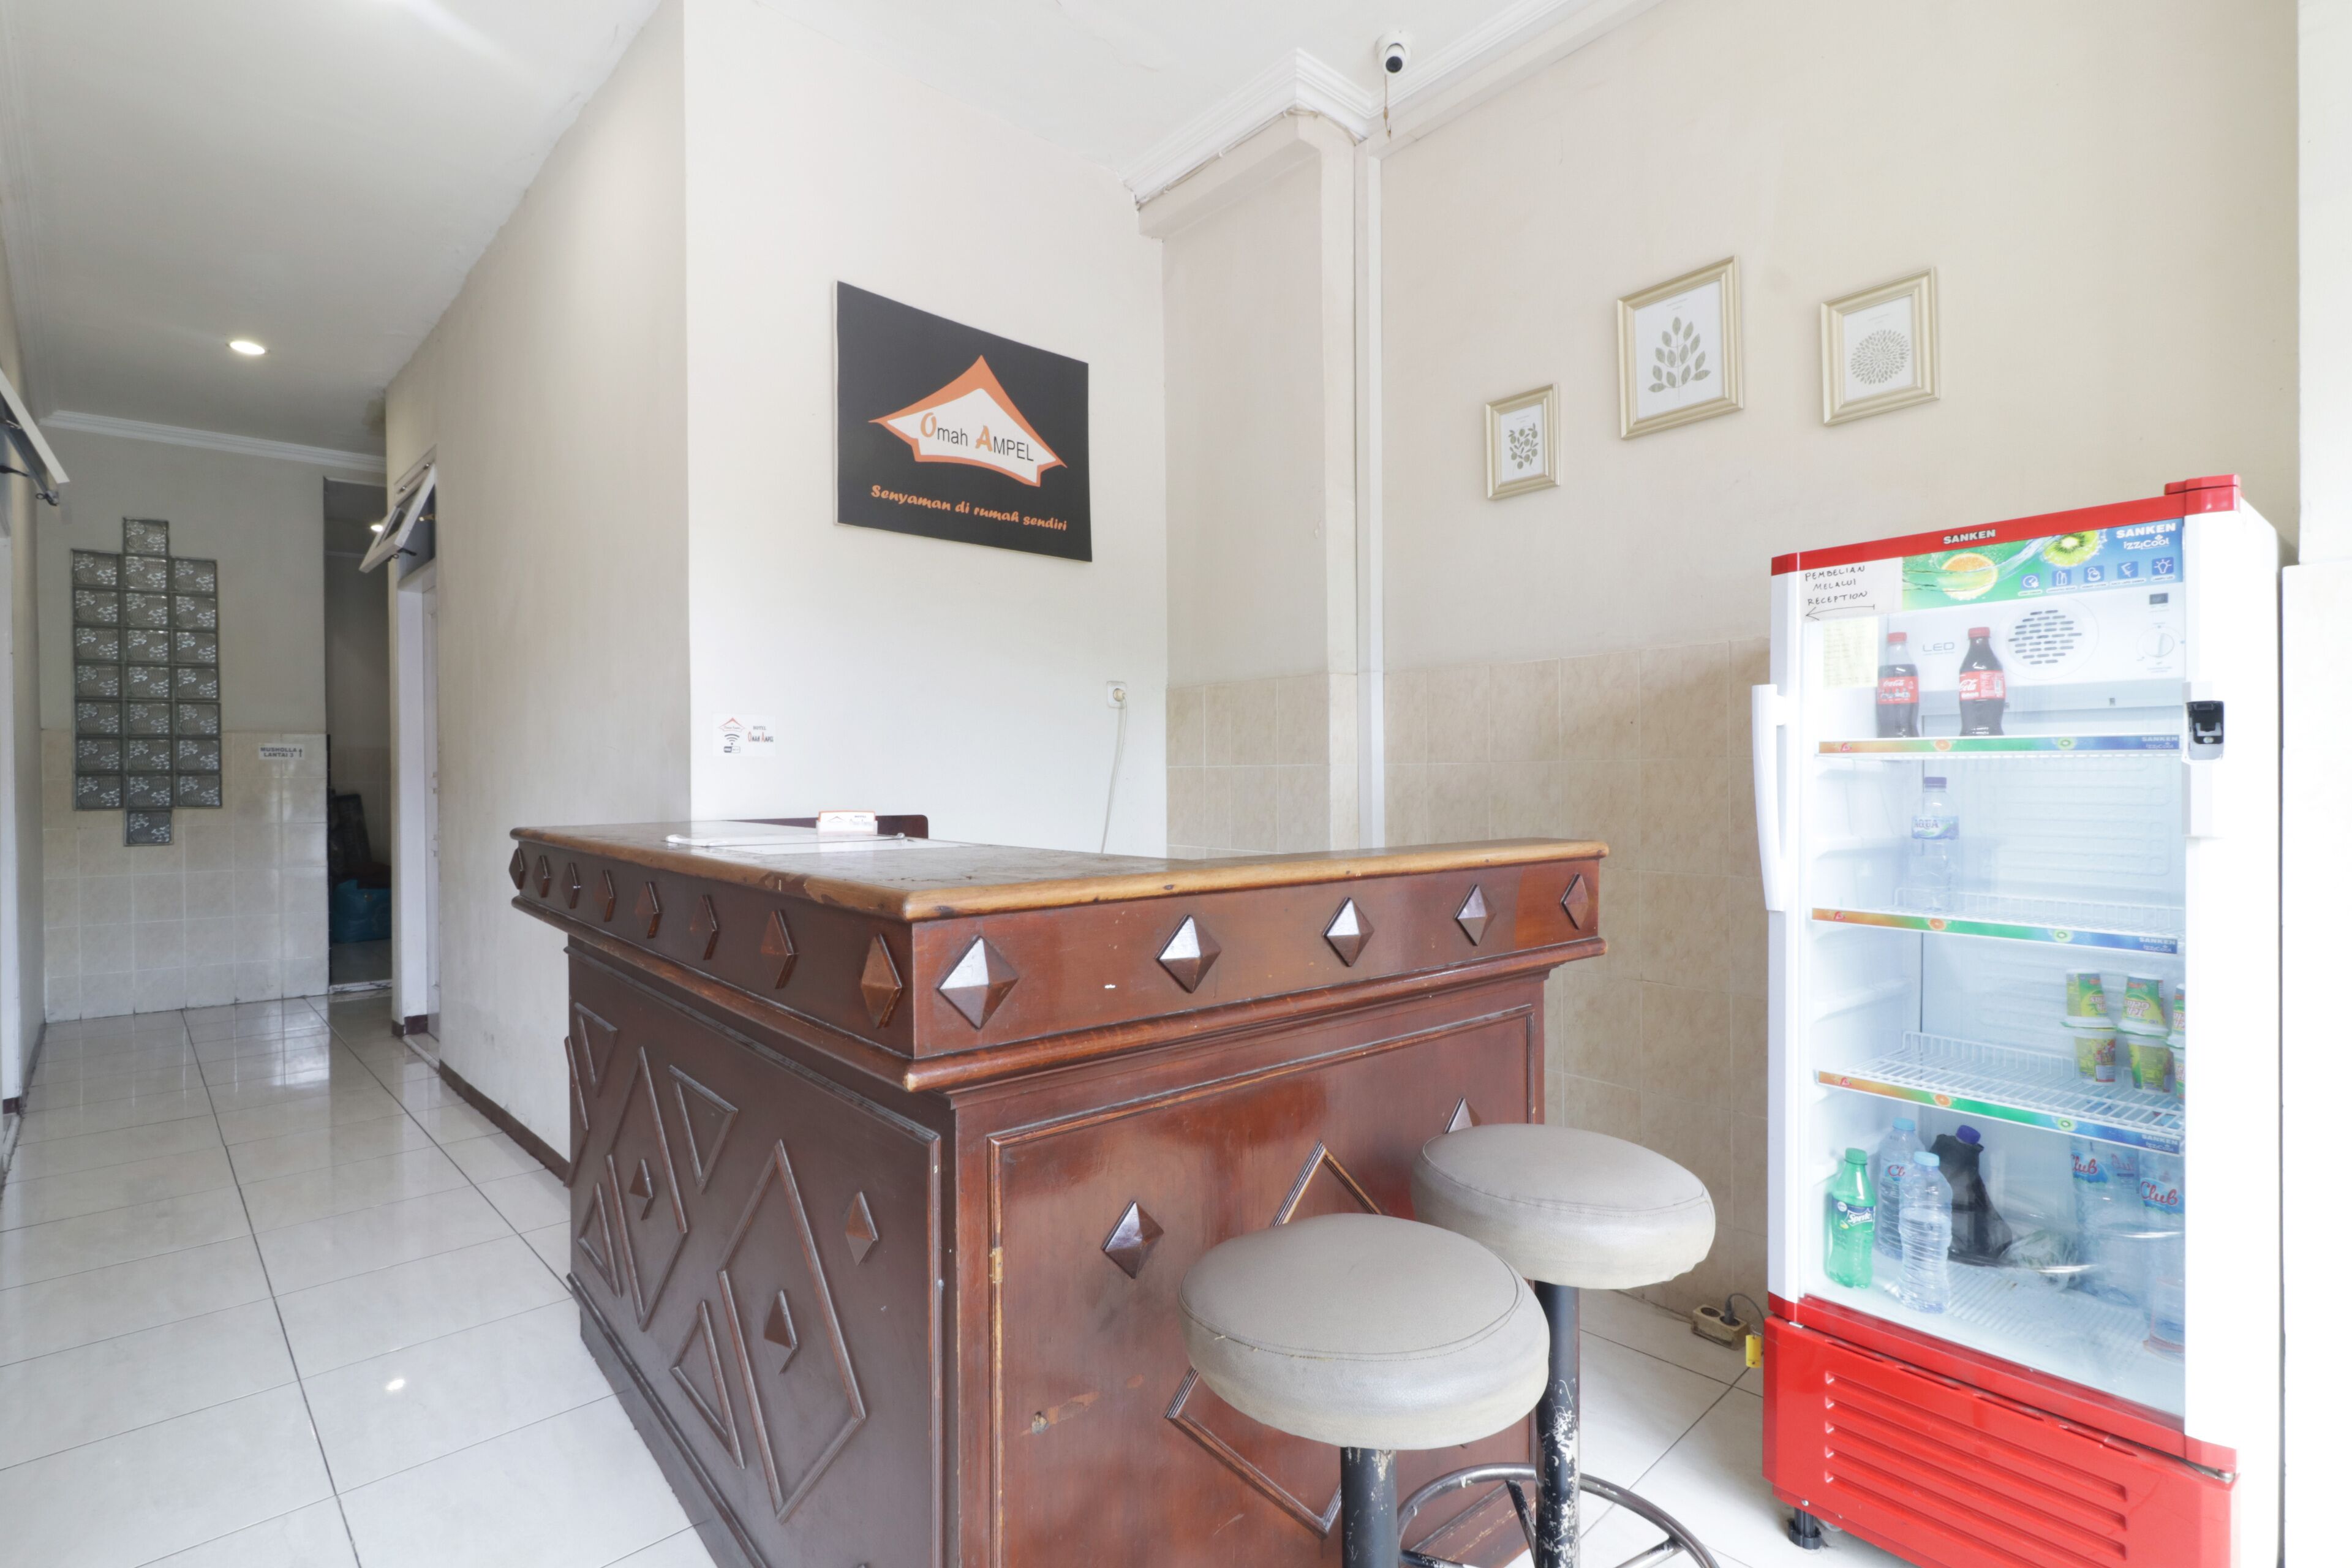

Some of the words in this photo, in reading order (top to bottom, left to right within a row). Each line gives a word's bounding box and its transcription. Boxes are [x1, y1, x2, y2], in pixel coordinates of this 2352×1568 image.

[920, 412, 968, 447] Omah
[975, 424, 1034, 462] AMPEL
[871, 485, 951, 511] Senyaman
[955, 501, 970, 514] di
[974, 506, 1019, 522] rumah
[1022, 516, 1068, 531] sendiri
[1943, 529, 1996, 545] SANKEN
[2116, 522, 2176, 538] SANKEN
[1804, 565, 1866, 581] PEMBELIAN
[1812, 578, 1856, 591] MELALUI
[1807, 590, 1868, 606] RECEPTION
[1922, 642, 1955, 652] LED
[1914, 819, 1939, 830] AQUA
[1888, 1164, 1905, 1177] Cl
[2140, 1181, 2178, 1206] Club
